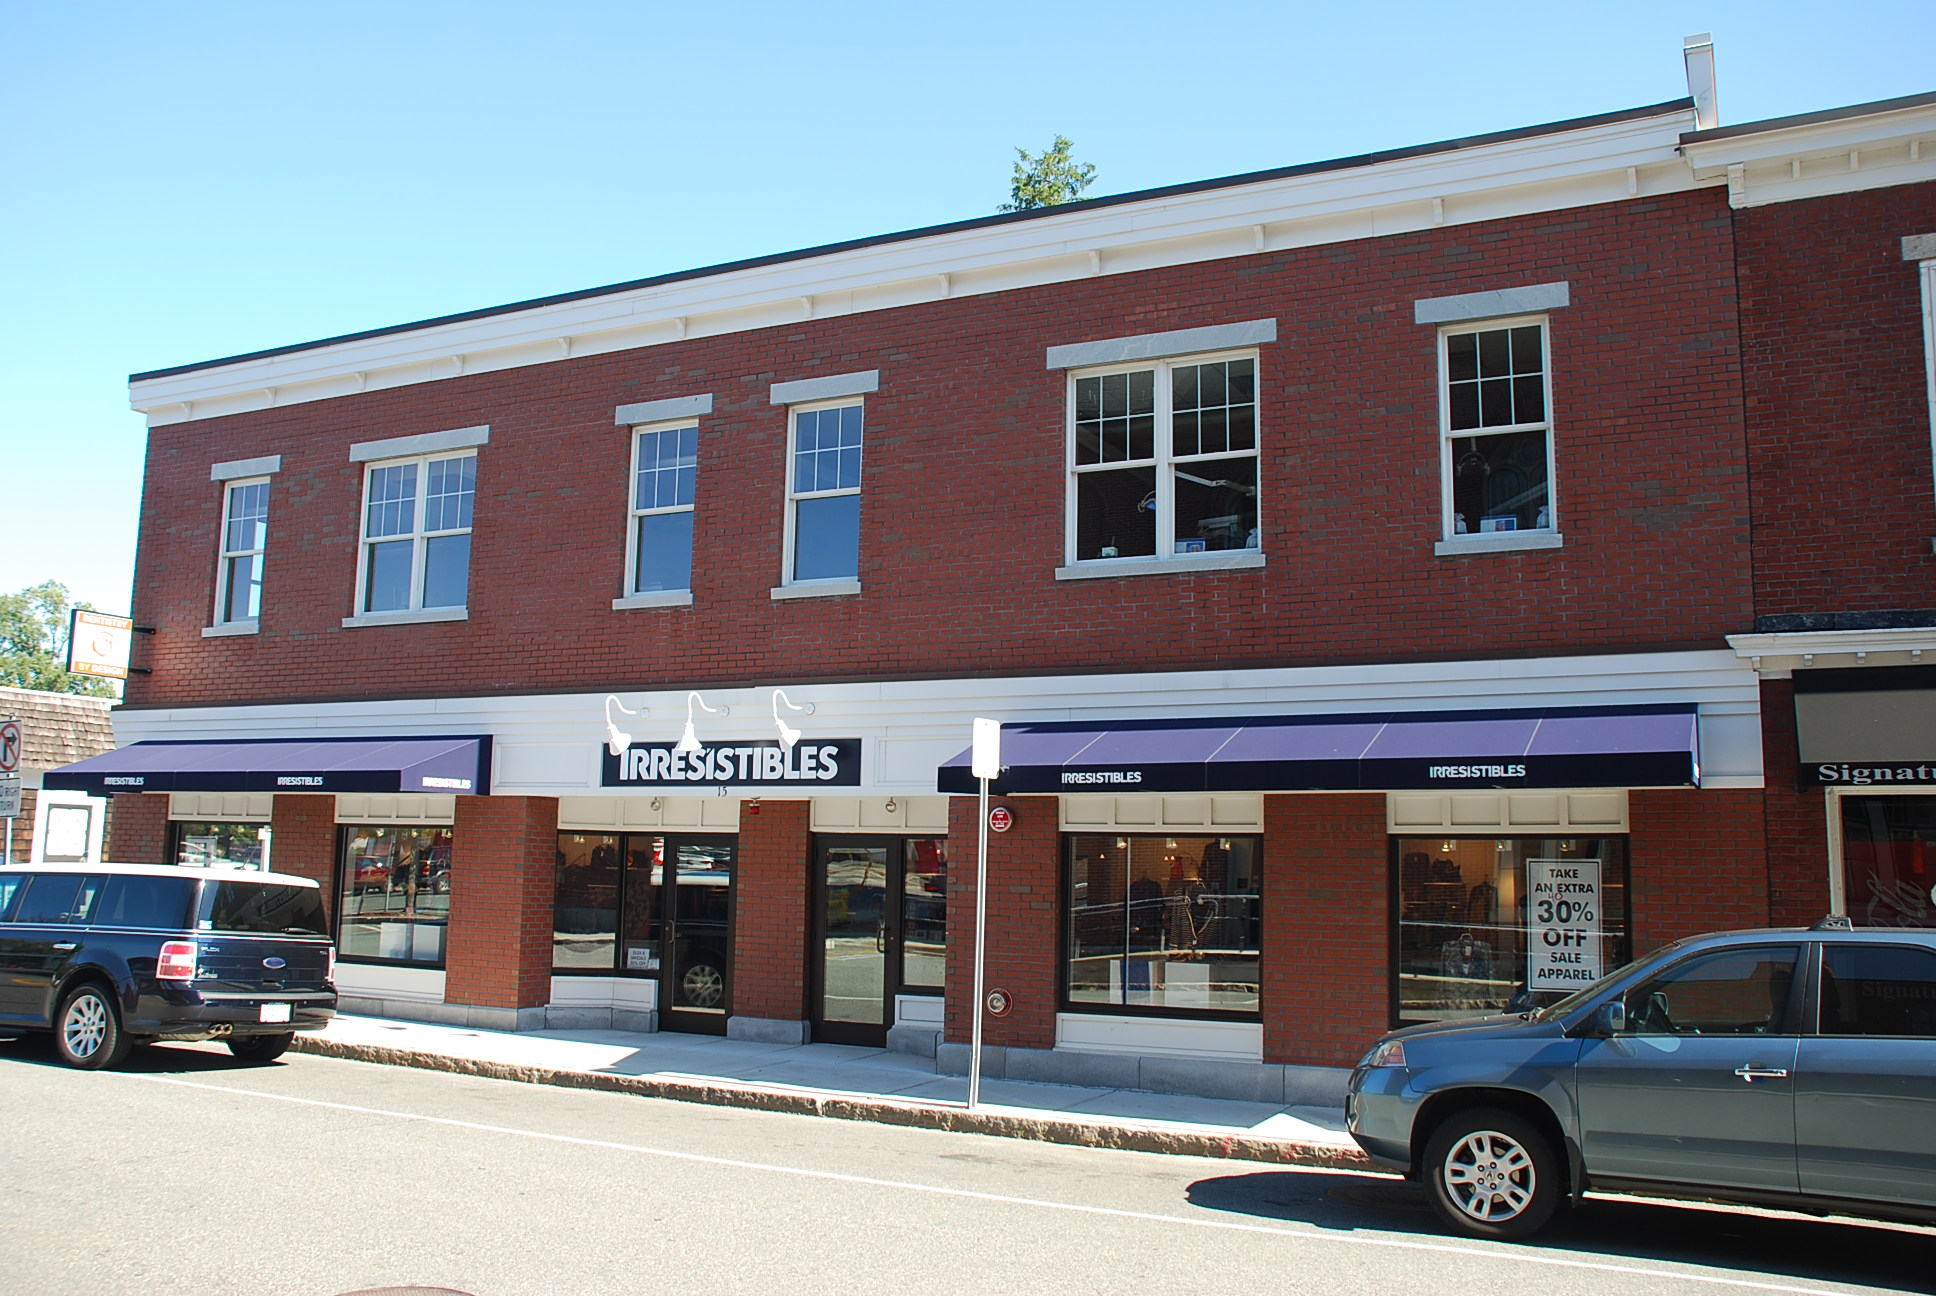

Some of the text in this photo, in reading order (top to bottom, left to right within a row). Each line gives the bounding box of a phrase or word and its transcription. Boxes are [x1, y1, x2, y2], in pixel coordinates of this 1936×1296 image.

[82, 614, 129, 629] DENTISTRY
[79, 662, 124, 676] BY DESIGN
[619, 745, 839, 781] IRRESISTIBLES
[1061, 771, 1142, 784] IRRESISTIBLES
[1429, 764, 1526, 778] IRRESISTIBLES
[104, 776, 144, 785] IRRESISTIBLES
[277, 776, 324, 786] IRRESISTIBLES
[717, 786, 728, 797] 15
[1549, 868, 1579, 879] TAKE
[1535, 883, 1594, 893] AN EXTRA
[1537, 900, 1594, 923] 30%
[1543, 928, 1587, 947] OFF
[1550, 952, 1582, 963] SALE
[1537, 968, 1595, 980] APPAREL
[1862, 981, 1936, 1002] Signat
